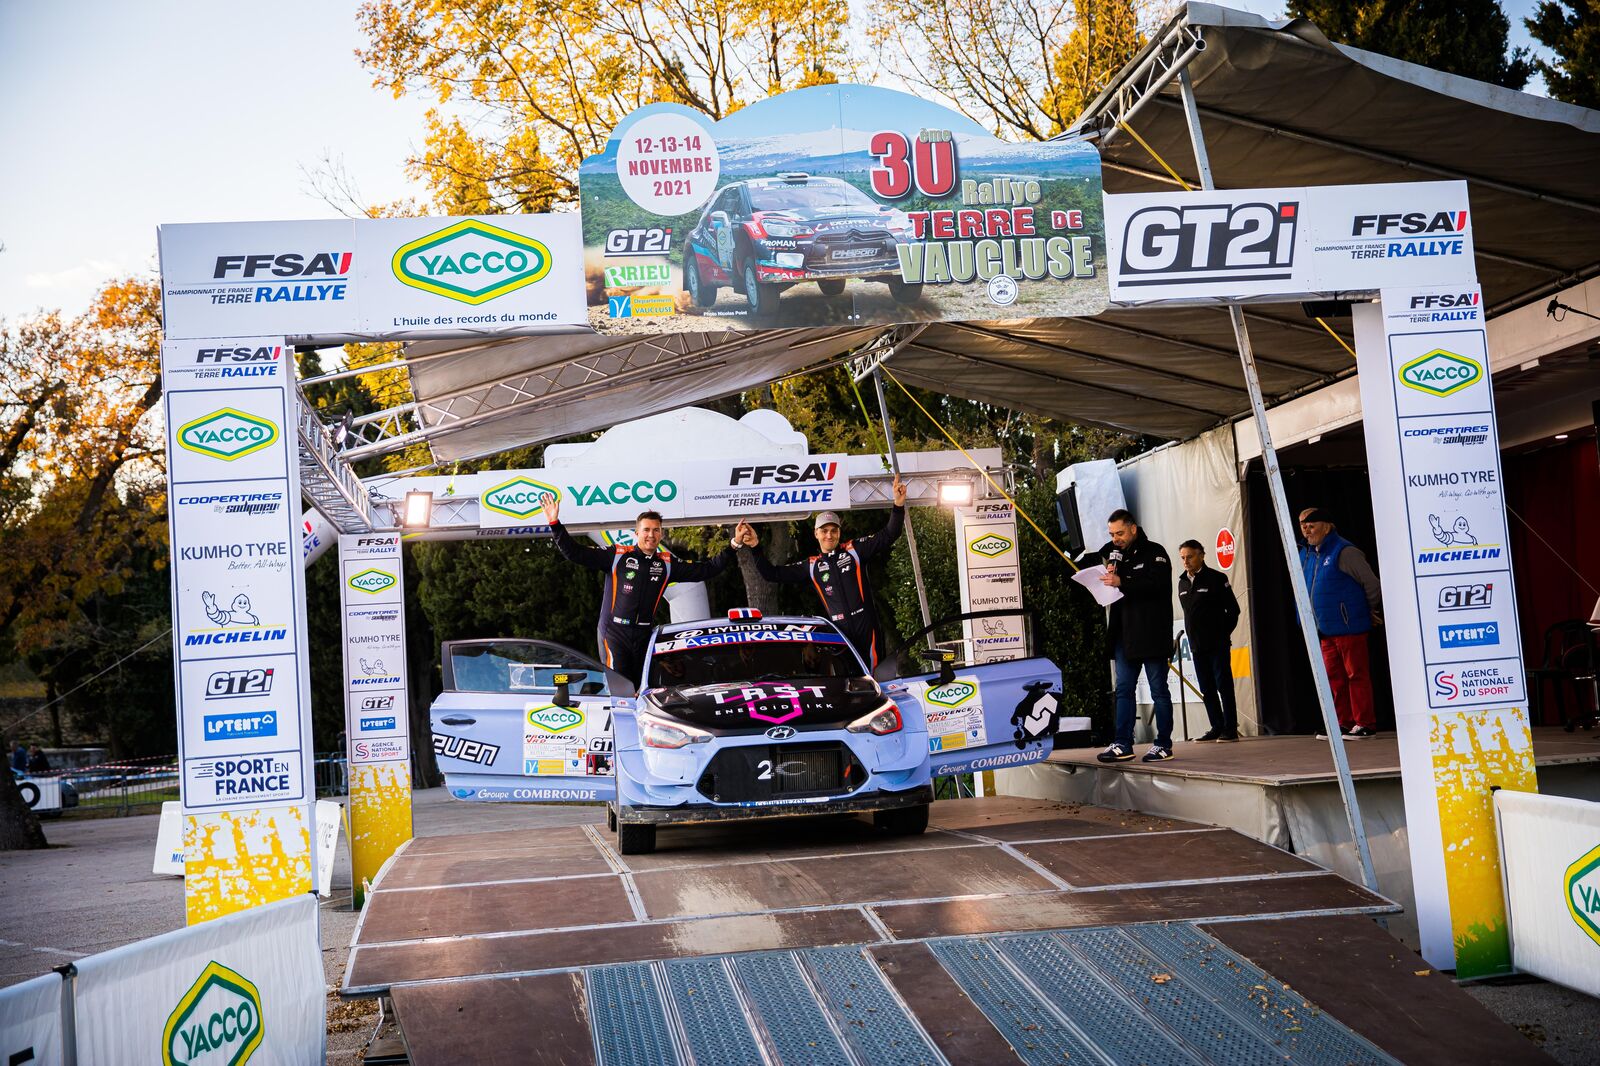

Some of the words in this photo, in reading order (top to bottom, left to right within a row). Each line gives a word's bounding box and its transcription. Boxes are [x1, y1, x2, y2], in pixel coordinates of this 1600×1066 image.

[634, 135, 702, 154] 12-13-14
[628, 156, 712, 176] NOVEMBRE
[870, 130, 956, 198] 30
[653, 180, 692, 197] 2021
[961, 178, 1042, 206] Rallye
[907, 207, 1036, 239] TERRE
[1050, 209, 1084, 230] DE
[1352, 213, 1455, 237] FFSA
[606, 227, 673, 252] GT2i
[1119, 200, 1300, 276] GT2i
[1351, 249, 1385, 260] TERRE
[1388, 240, 1464, 258] RALLYE
[213, 253, 338, 279] FFSA
[417, 250, 529, 277] YACCO
[895, 235, 1095, 285] VAUCLUSE
[167, 289, 216, 297] CHAMPIONNAT
[211, 293, 252, 305] TERRE
[254, 284, 348, 304] RALLYE
[1410, 293, 1472, 309] FFSA
[393, 314, 430, 327] L'huile
[434, 313, 454, 325] des
[456, 313, 499, 325] records
[502, 311, 516, 323] du
[519, 310, 558, 322] monde
[1431, 310, 1478, 322] RALLYE
[196, 347, 273, 363] FFSA
[221, 366, 278, 378] RALLYE
[1411, 366, 1469, 382] YACCO
[193, 425, 265, 444] YACCO
[1404, 425, 1489, 437] COOPERTIRES
[729, 464, 826, 486] FFSA
[1408, 472, 1460, 488] KUMHO
[1460, 469, 1496, 484] TYRE
[178, 492, 284, 505] COOPERTIRES
[567, 479, 678, 507] YACCO
[761, 488, 833, 505] RALLYE
[728, 498, 760, 508] TERRE
[976, 503, 1010, 513] FFSA
[357, 537, 395, 547] FFSA
[369, 546, 397, 554] RALLYE
[976, 541, 1008, 551] YACCO
[180, 543, 243, 561] KUMHO
[246, 541, 287, 557] TYRE
[1418, 548, 1501, 564] MICHELIN
[356, 577, 390, 587] YACCO
[971, 597, 999, 606] KUMHO
[999, 595, 1019, 604] TYRE
[1439, 583, 1493, 609] GT2i
[184, 628, 287, 647] MICHELIN
[707, 624, 778, 635] HYUNDAI
[349, 634, 380, 645] KUMHO
[381, 632, 401, 643] TYRE
[351, 676, 401, 686] MICHELIN
[1461, 667, 1500, 679] AGENCE
[205, 668, 274, 697] GT2i
[1461, 676, 1514, 688] NATIONALE
[706, 685, 827, 704] TRST
[932, 686, 970, 700] YACCO
[1463, 688, 1477, 698] DU
[1478, 685, 1510, 697] SPORT
[537, 713, 577, 722] YACCO
[371, 741, 394, 749] AGENCE
[371, 744, 402, 753] NATIONALE
[371, 750, 380, 758] DU
[381, 749, 399, 757] SPORT
[970, 749, 1045, 770] COMBRONDE
[214, 758, 273, 777] SPORT
[274, 761, 289, 773] EN
[757, 759, 772, 780] 2
[937, 764, 967, 775] Groupe
[215, 774, 290, 796] FRANCE
[477, 788, 509, 800] Groupe
[513, 788, 597, 800] COMBRONDE
[180, 1001, 252, 1061] YACCO
